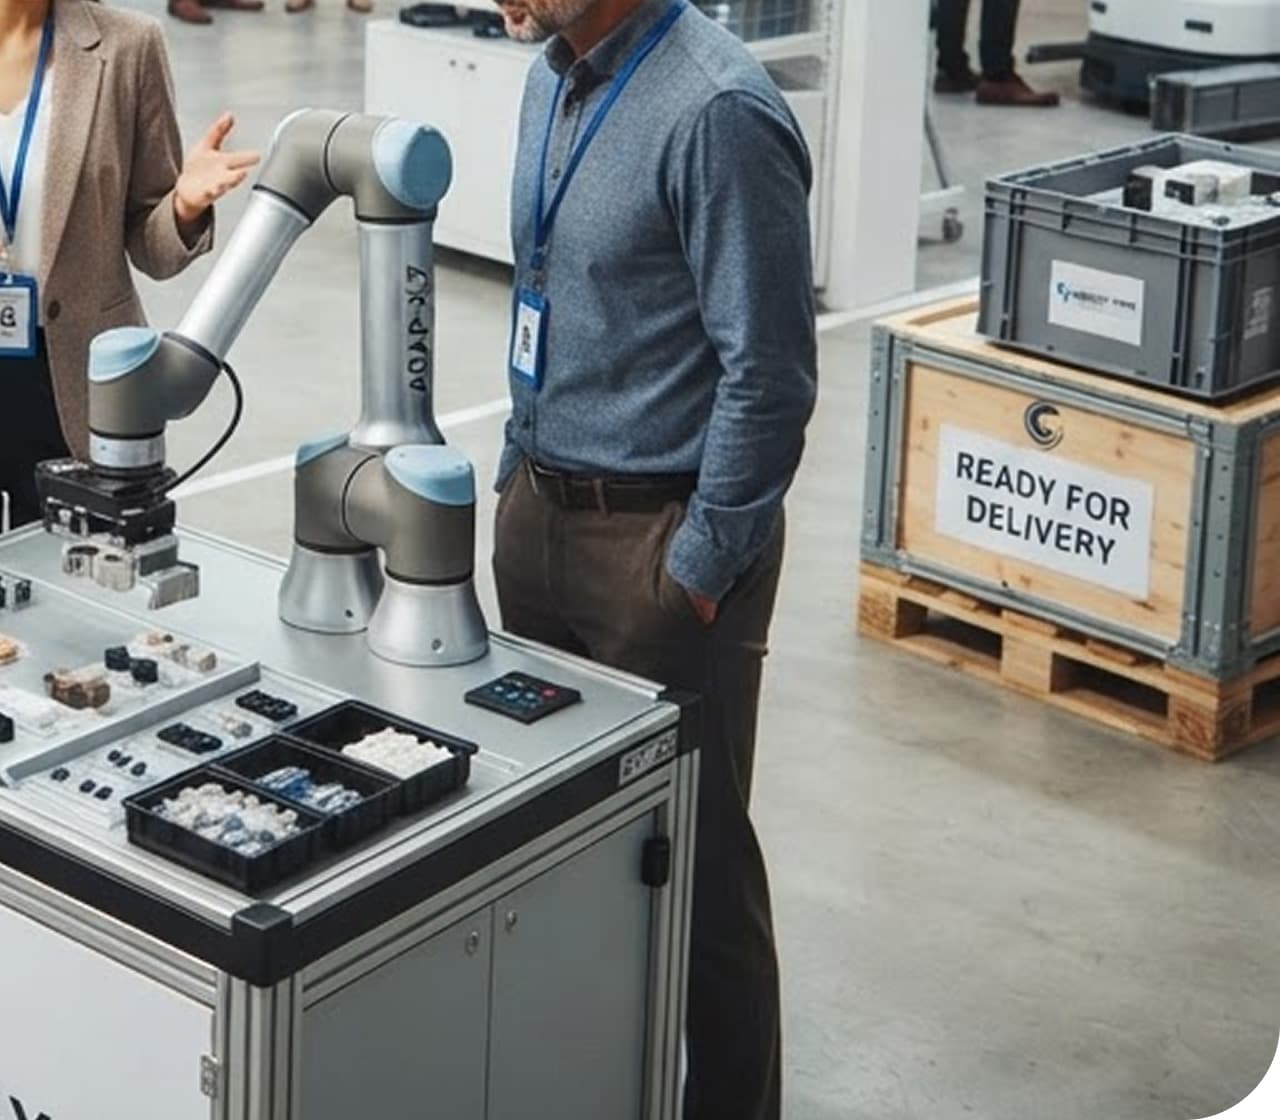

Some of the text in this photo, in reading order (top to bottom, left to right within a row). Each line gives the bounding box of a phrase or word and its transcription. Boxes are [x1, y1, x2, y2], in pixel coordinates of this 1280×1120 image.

[955, 451, 1132, 532] READY FOR
[966, 494, 1117, 567] DELIVERY
